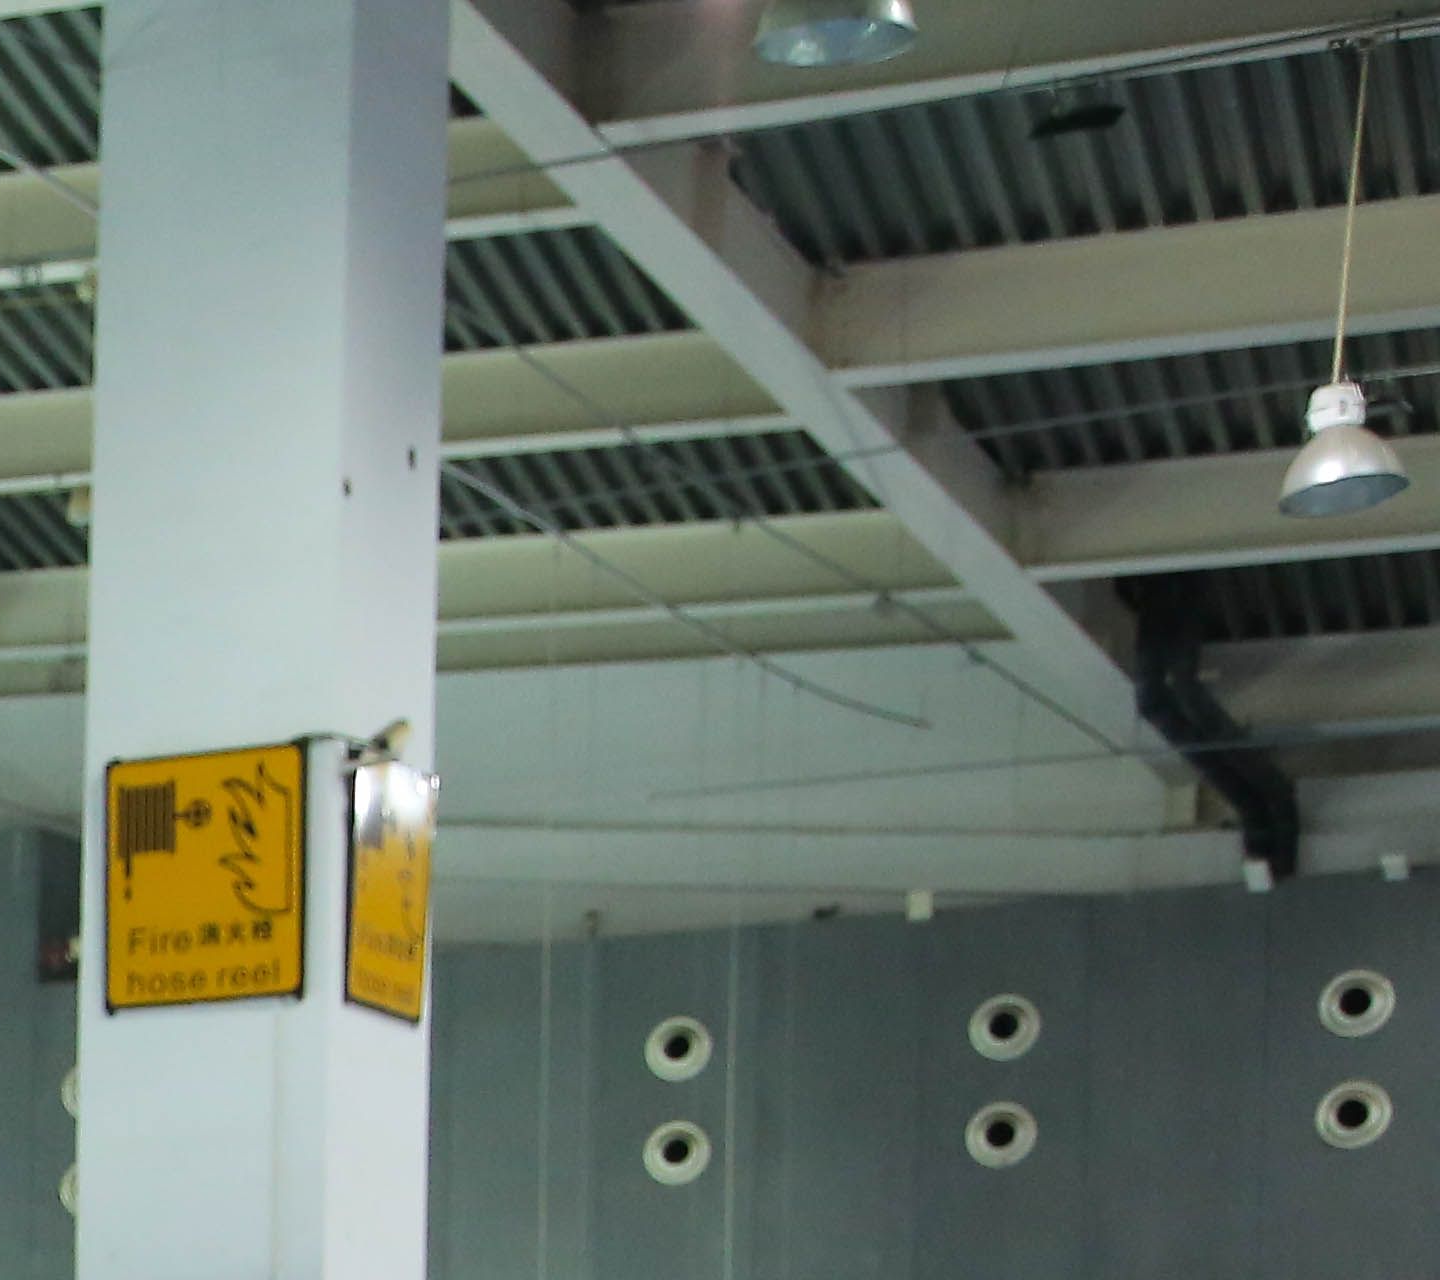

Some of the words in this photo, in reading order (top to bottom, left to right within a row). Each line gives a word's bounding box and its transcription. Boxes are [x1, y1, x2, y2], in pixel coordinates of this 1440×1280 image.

[128, 926, 192, 955] Fire
[126, 967, 207, 994] hose
[216, 957, 281, 988] reel
